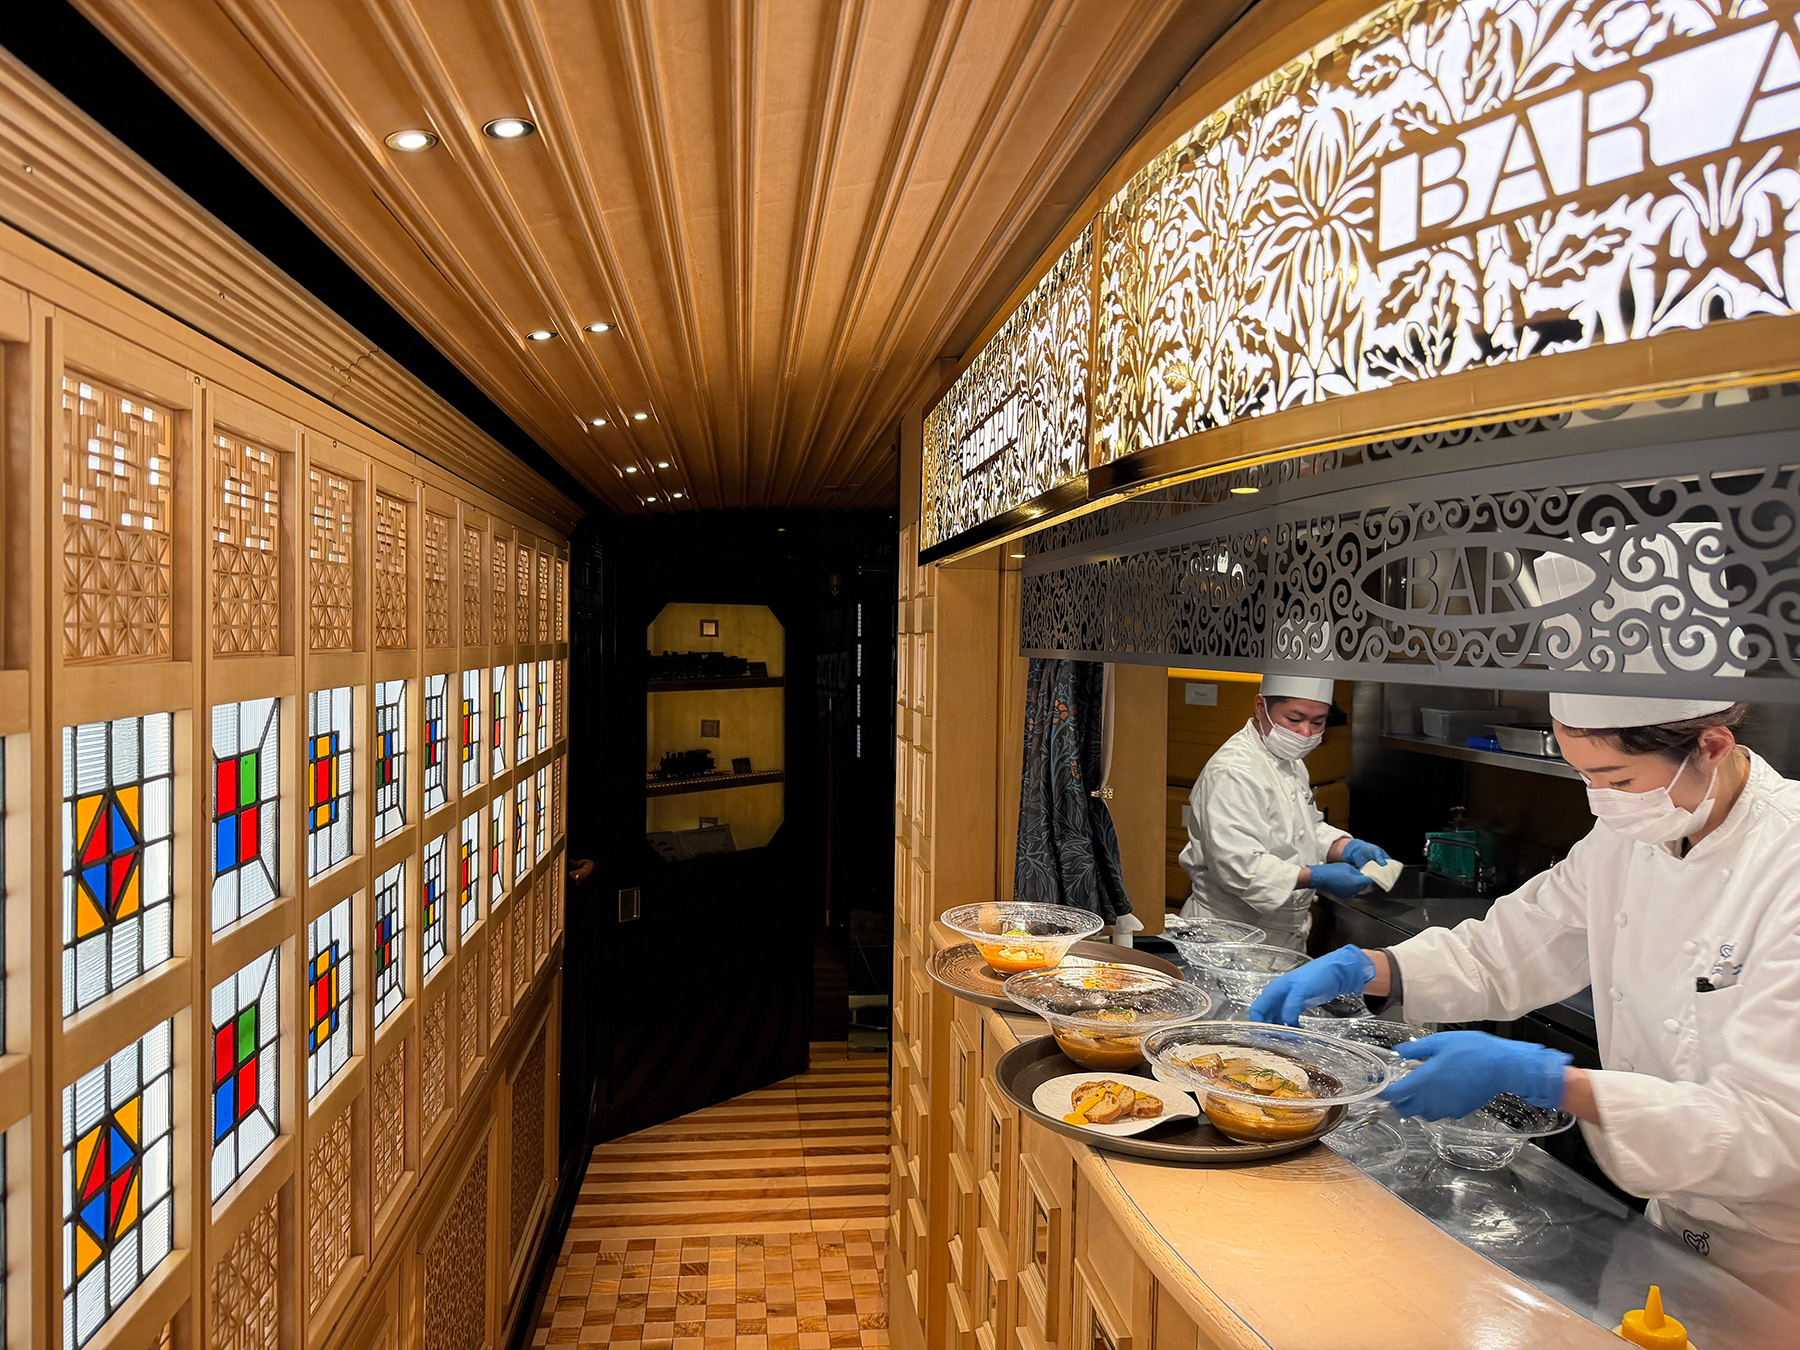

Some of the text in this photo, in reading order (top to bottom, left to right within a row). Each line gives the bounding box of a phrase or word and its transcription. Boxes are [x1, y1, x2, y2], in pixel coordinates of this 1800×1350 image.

[1416, 74, 1655, 235] BAR
[965, 423, 986, 474] BAR
[1405, 546, 1525, 615] BAR
